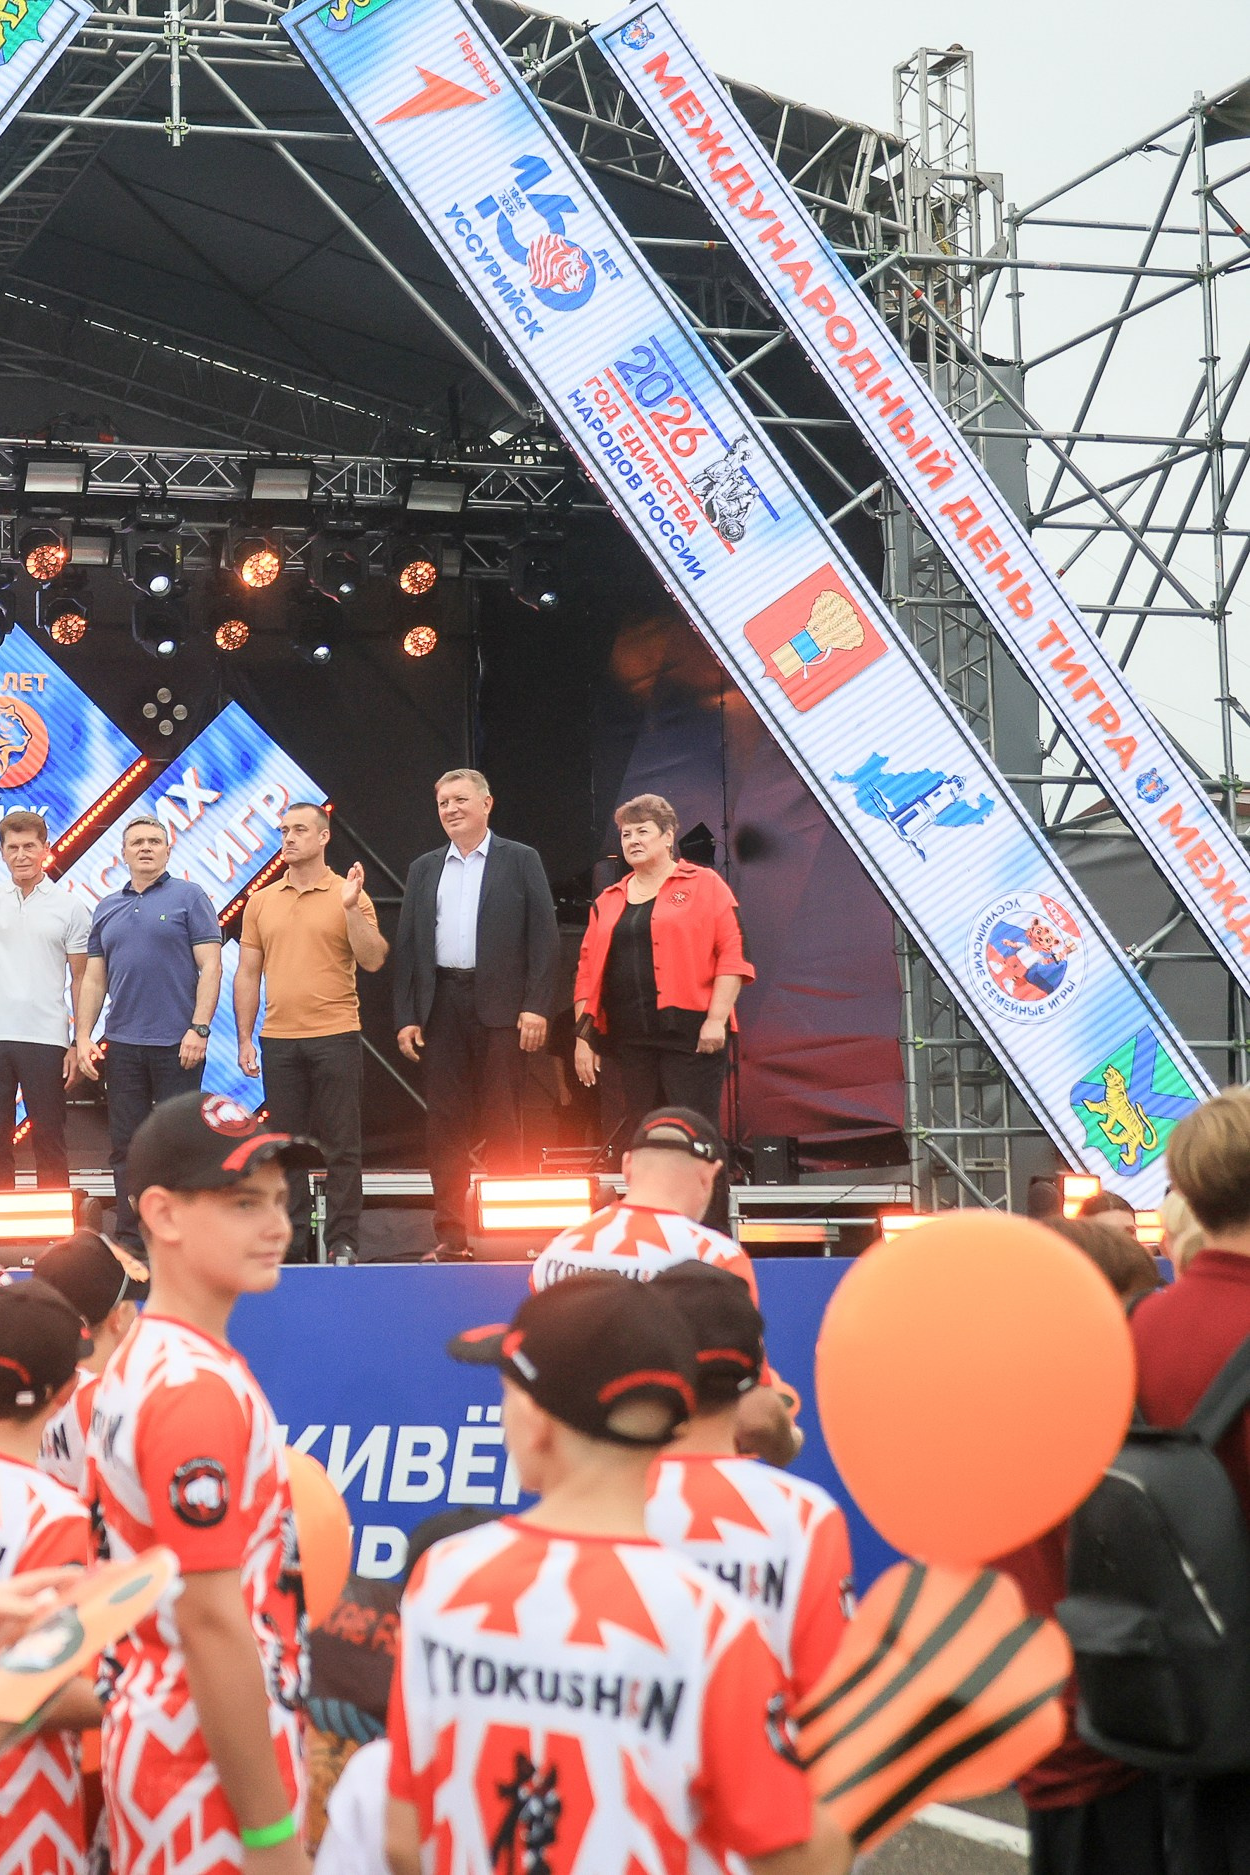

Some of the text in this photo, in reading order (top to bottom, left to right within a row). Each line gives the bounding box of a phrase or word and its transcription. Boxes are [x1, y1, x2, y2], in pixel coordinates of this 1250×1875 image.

[454, 31, 502, 95] Первые
[497, 193, 517, 217] 2026
[508, 186, 526, 211] 1866
[444, 203, 545, 340] УССУРИЙСК
[592, 248, 624, 281] ЛЕТ
[613, 345, 709, 458] 2026
[642, 50, 1141, 772] МЕЖДУНАРОДНЫЙ ДЕНЬ ТИГРА
[567, 388, 707, 581] НАРОДОВ РОССИИ
[584, 376, 699, 537] ГОД ЕДИНСТВА
[1, 672, 48, 692] ЛЕТ
[196, 783, 290, 884] ИГР
[982, 980, 1045, 1016] СЕМЕЙНЫЕ
[1049, 979, 1076, 1010] ИГРЫ
